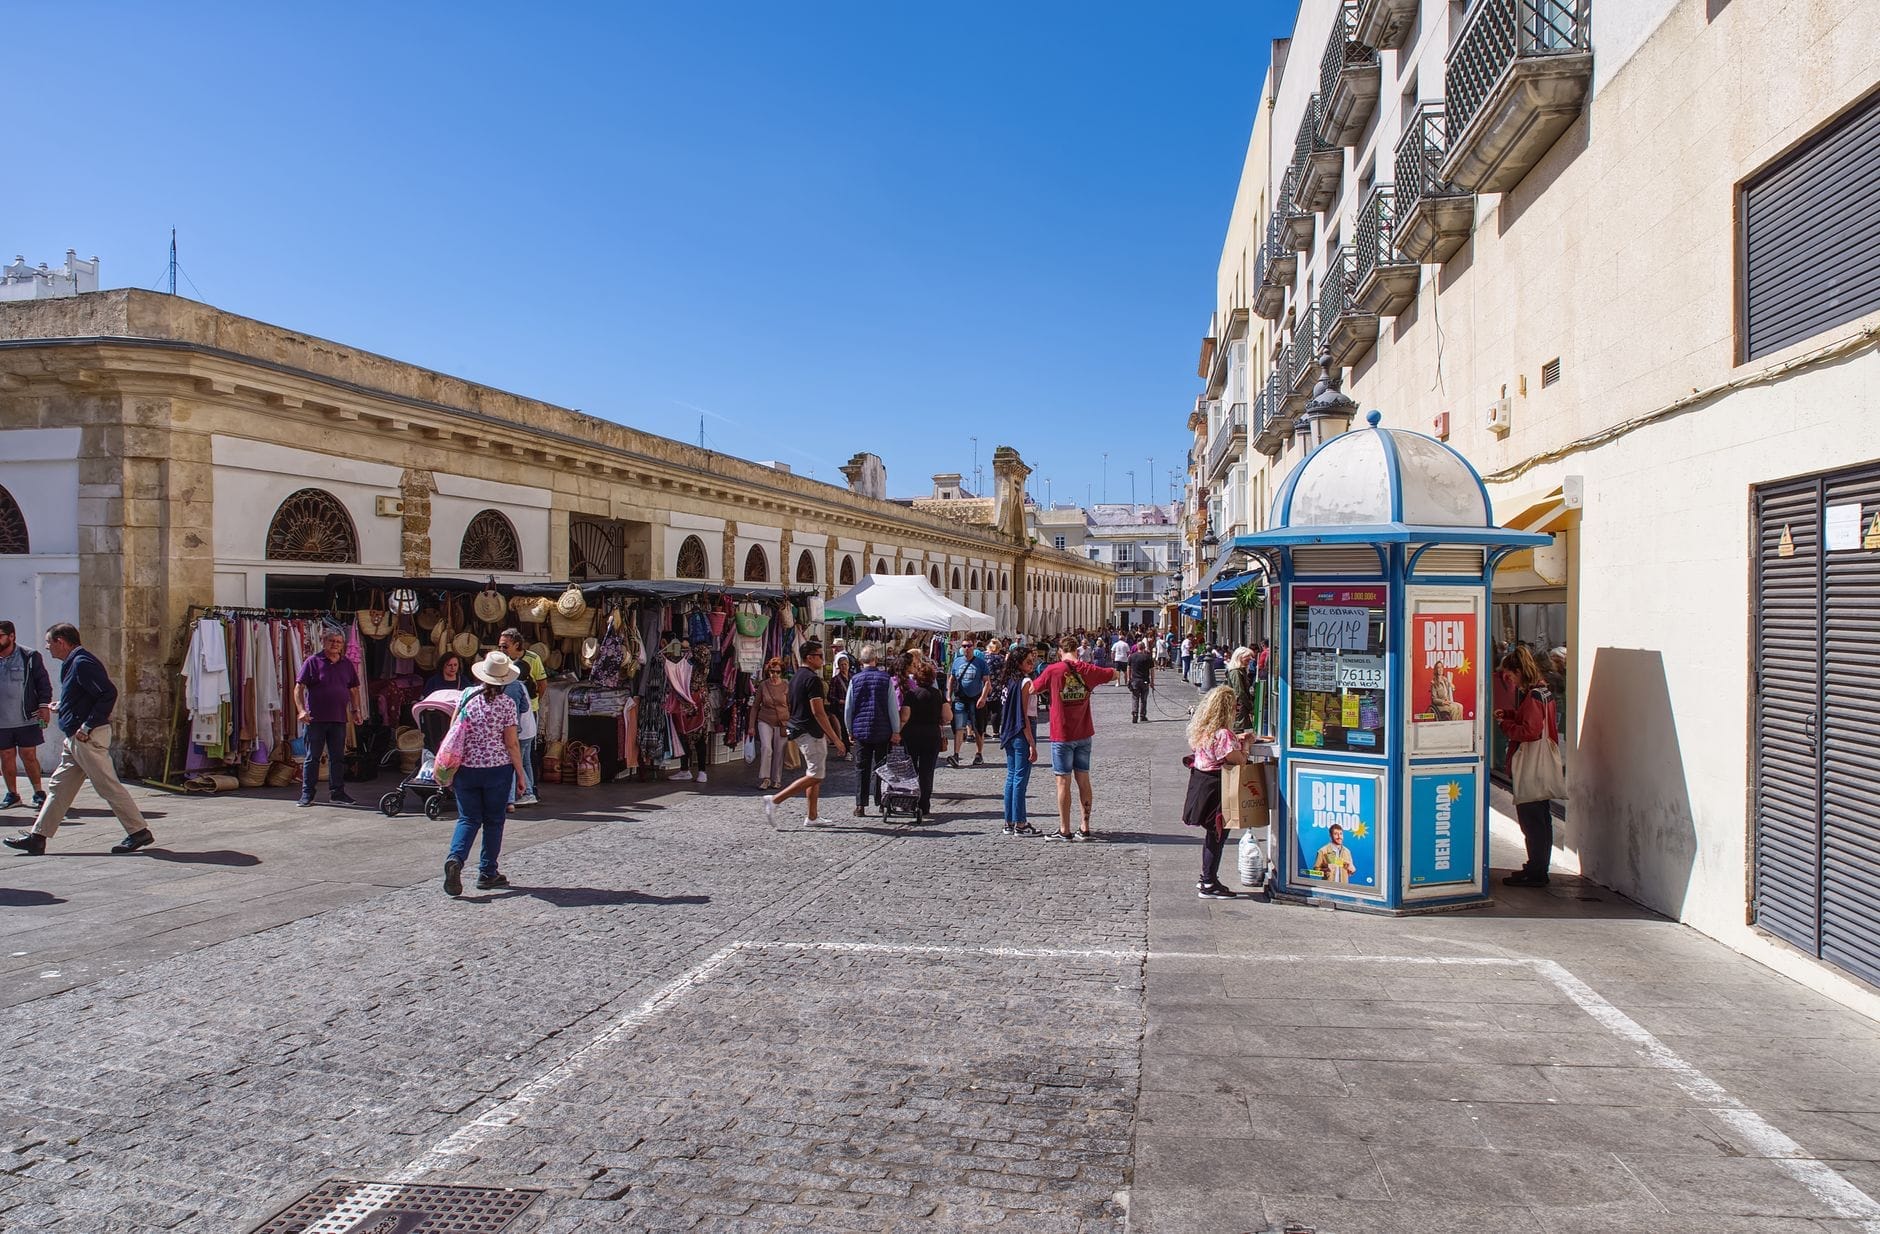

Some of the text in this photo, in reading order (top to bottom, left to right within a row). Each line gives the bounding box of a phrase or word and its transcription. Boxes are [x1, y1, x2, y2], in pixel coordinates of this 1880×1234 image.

[1424, 621, 1464, 651] BIEN
[1425, 651, 1464, 669] JUGADO
[1341, 669, 1382, 681] 76113
[1312, 781, 1360, 814] BIEN
[1312, 811, 1360, 831] JUGADO
[1435, 784, 1451, 870] BIEN JUGADO
